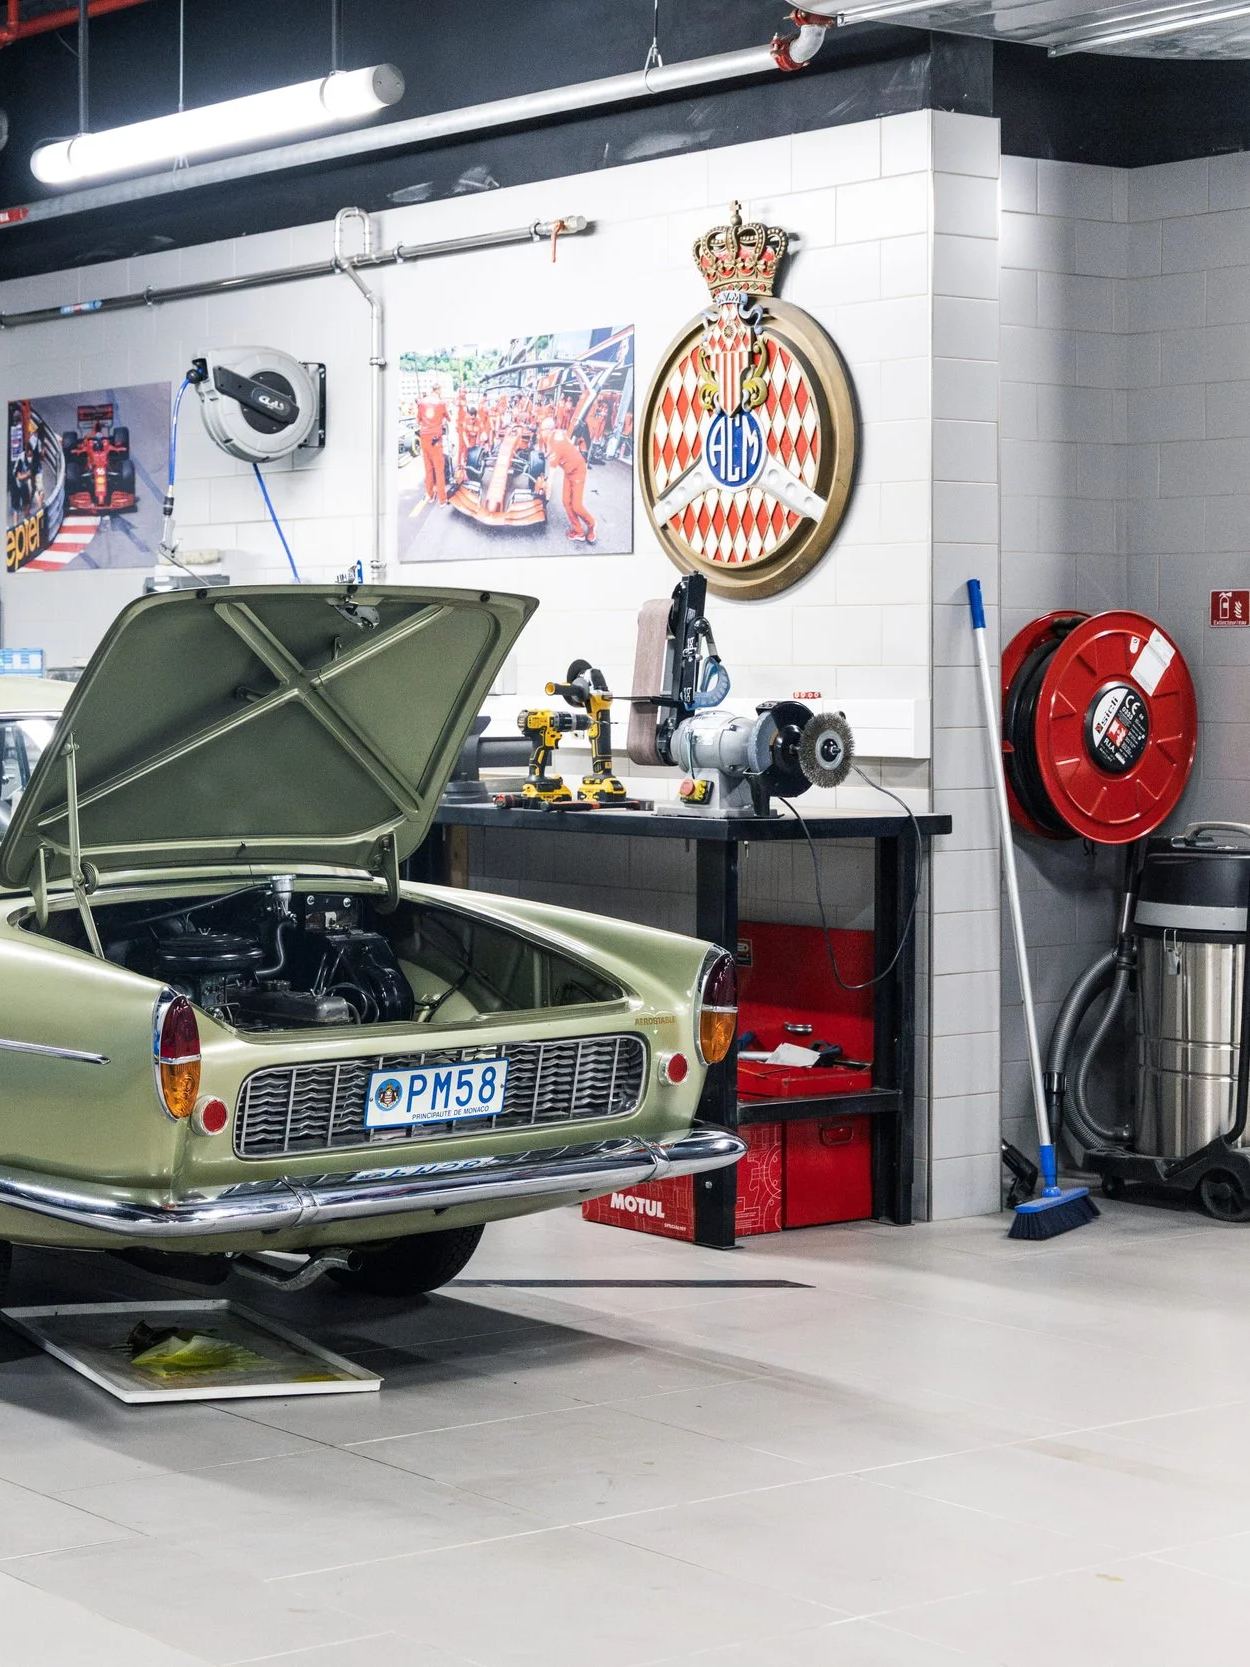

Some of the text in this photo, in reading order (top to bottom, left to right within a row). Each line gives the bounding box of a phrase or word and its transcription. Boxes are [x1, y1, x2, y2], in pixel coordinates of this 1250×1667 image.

[406, 1066, 497, 1113] PM58
[412, 1110, 451, 1120] PRINCIPAUTE
[464, 1105, 490, 1115] MONACO
[610, 1192, 666, 1218] MOTUL
